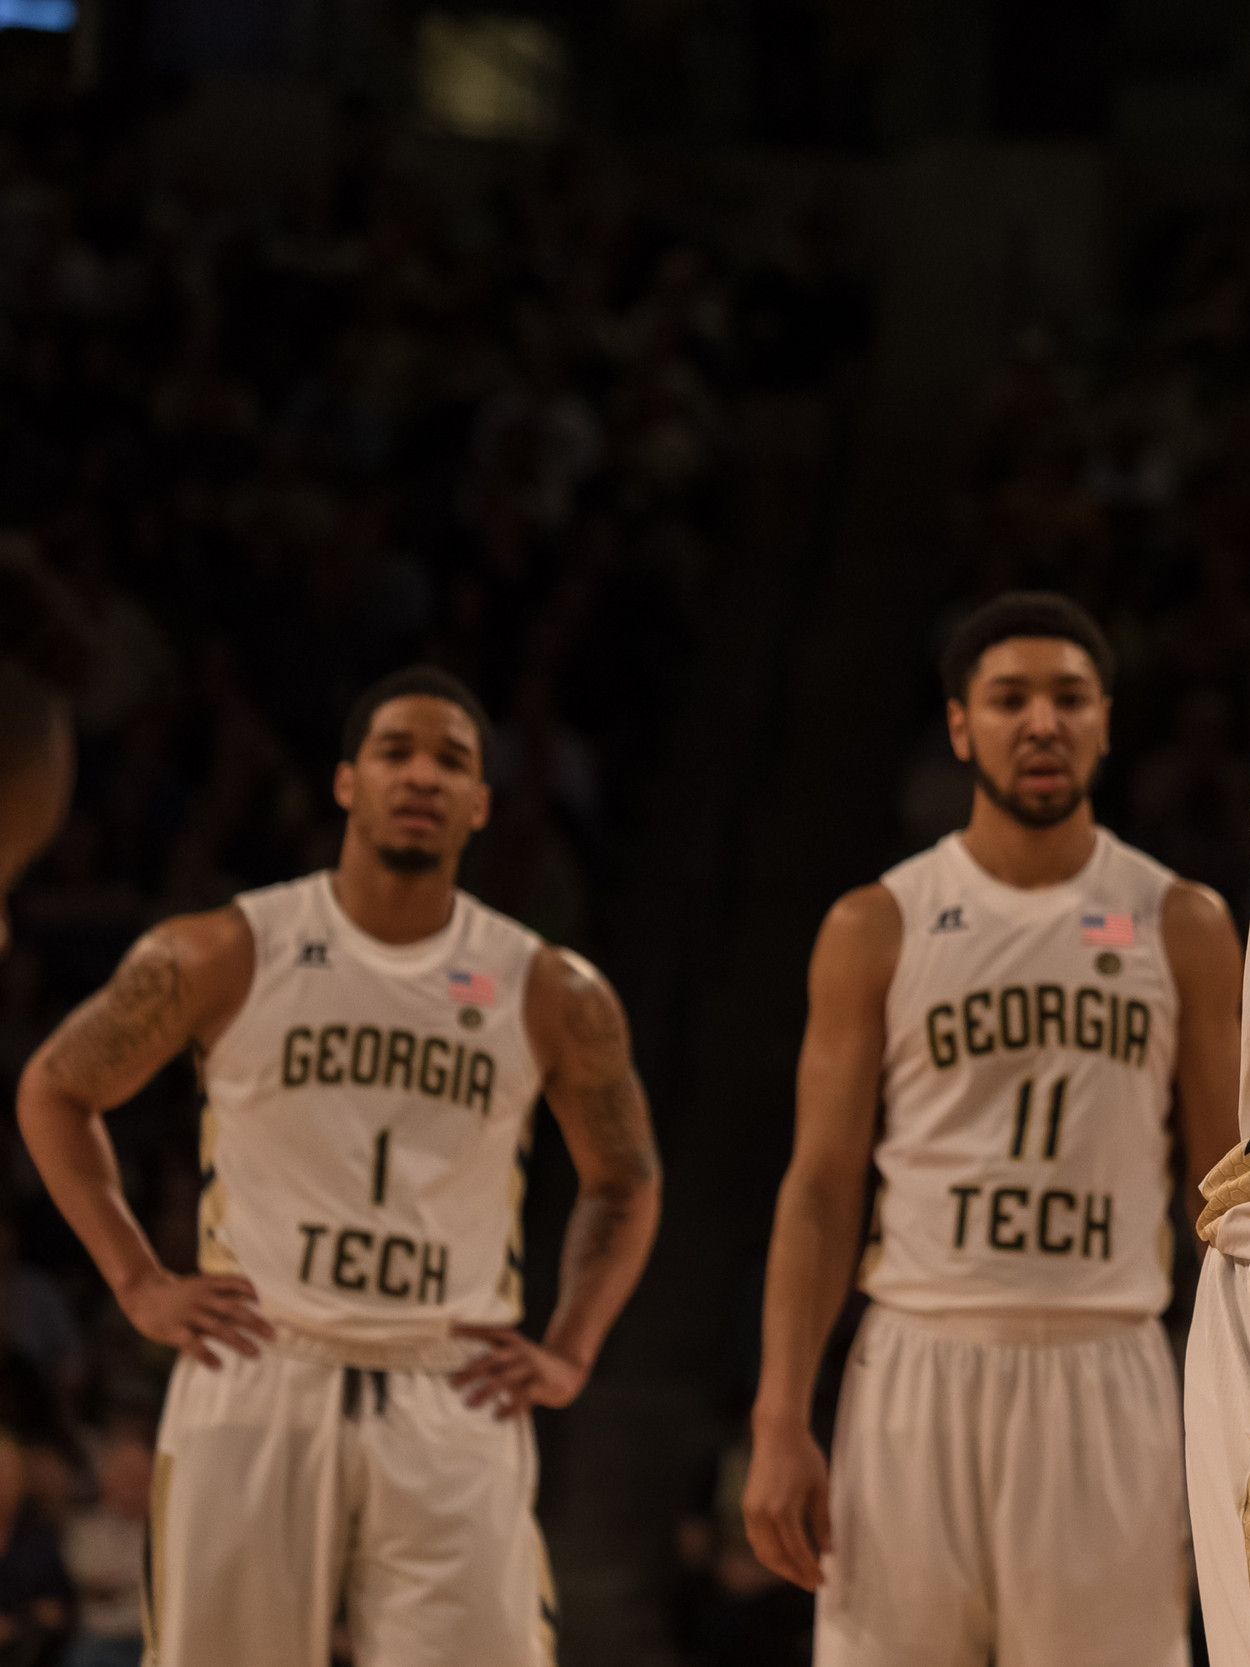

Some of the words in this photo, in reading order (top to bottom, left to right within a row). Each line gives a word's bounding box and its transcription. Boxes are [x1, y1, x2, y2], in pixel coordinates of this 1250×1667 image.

[281, 1023, 497, 1116] GEORGIA
[926, 984, 1152, 1070] GEORGIA
[1009, 1077, 1067, 1162] 11
[370, 1128, 391, 1206] 1
[297, 1221, 449, 1307] TECH
[948, 1186, 1113, 1262] TECH
